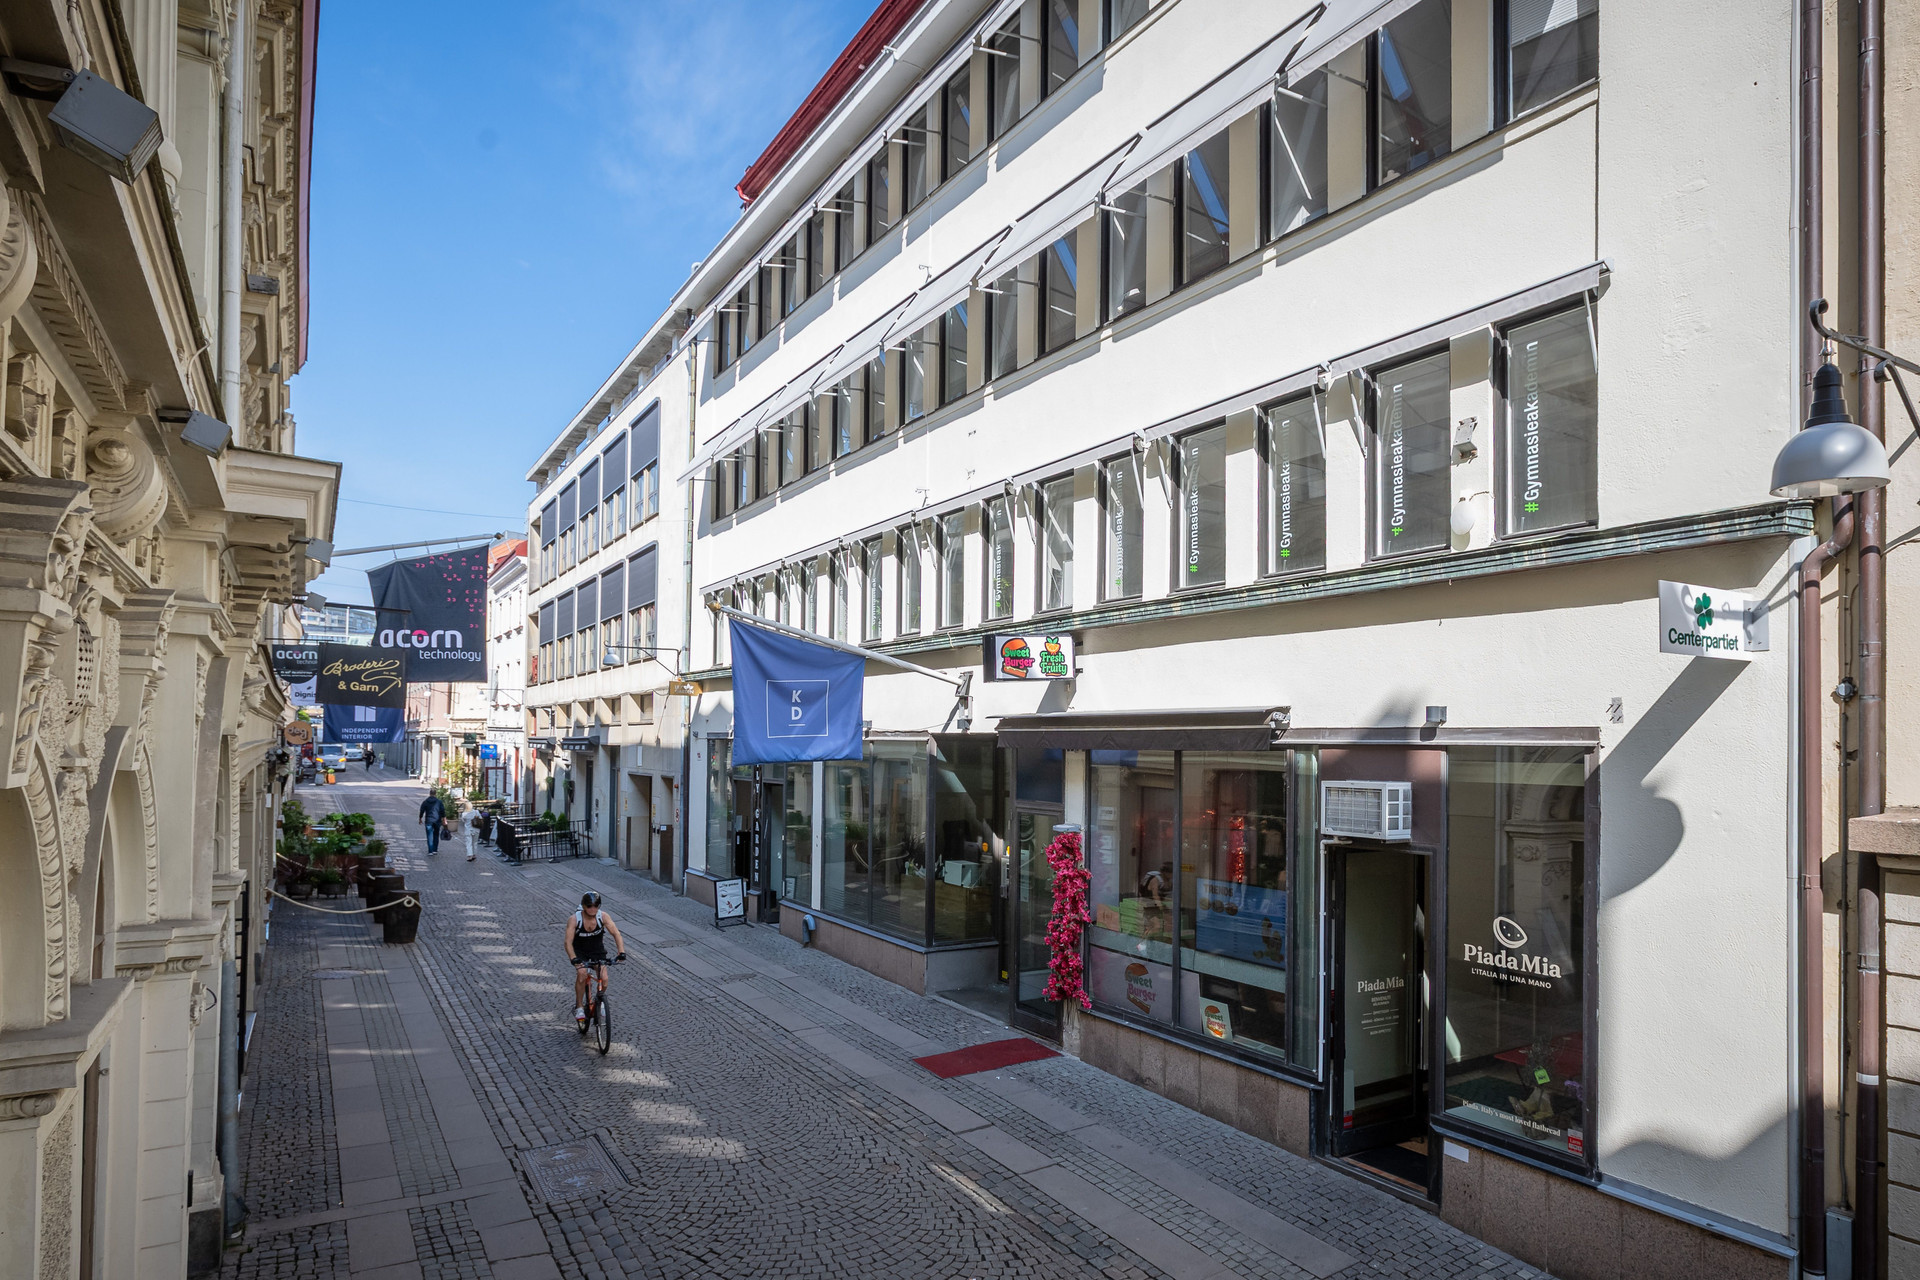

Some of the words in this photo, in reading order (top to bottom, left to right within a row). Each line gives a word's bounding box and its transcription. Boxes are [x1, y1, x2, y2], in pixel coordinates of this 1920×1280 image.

[1524, 341, 1542, 512] #Gymnasieakademin
[379, 629, 463, 649] acorn
[1668, 628, 1739, 652] Centerpartiet
[276, 650, 318, 660] acorn
[419, 649, 482, 662] technology
[1004, 647, 1030, 658] Sweet
[1040, 651, 1065, 663] Fresh
[322, 657, 399, 676] Broderi
[1004, 657, 1035, 669] Burger
[1040, 662, 1068, 676] Fruity
[337, 681, 347, 690] &
[350, 682, 379, 692] Garn
[791, 690, 802, 703] K
[791, 706, 803, 720] D
[1463, 943, 1519, 970] Piada
[1521, 953, 1562, 978] Mia
[1127, 970, 1153, 989] Sweet
[1357, 979, 1385, 993] Piada
[1386, 976, 1405, 989] Mia
[1471, 967, 1498, 979] L'ITALIA
[1500, 972, 1508, 981] IN
[1509, 975, 1526, 985] UNA
[1528, 978, 1552, 989] MANO
[1128, 983, 1156, 1002] Burger
[1206, 1010, 1224, 1022] Sweet
[1207, 1017, 1227, 1030] Burger
[1481, 1103, 1498, 1116] Italy's
[1499, 1108, 1515, 1122] most
[1515, 1116, 1532, 1127] loved
[1532, 1120, 1560, 1137] flatbread
